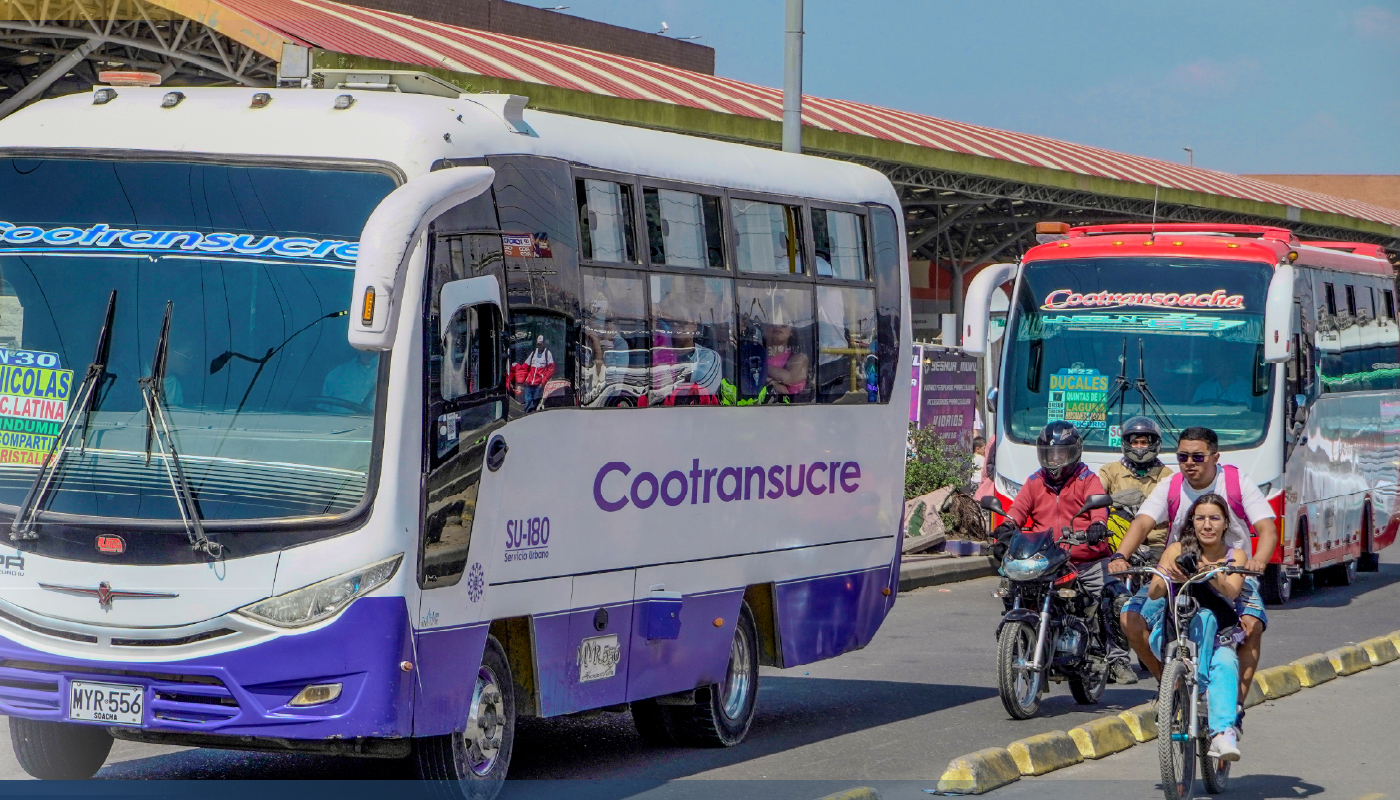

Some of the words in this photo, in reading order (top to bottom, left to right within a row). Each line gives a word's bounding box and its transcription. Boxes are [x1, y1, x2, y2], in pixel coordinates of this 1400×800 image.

[1045, 289, 1244, 308] Cootransoacha
[1050, 376, 1108, 390] DUCALES
[0, 396, 64, 421] C.LATINA
[593, 458, 861, 512] Cootransucre
[506, 516, 550, 549] SU-180
[504, 552, 528, 562] Servicio
[529, 550, 549, 559] Urbano
[94, 712, 118, 720] SOACHA
